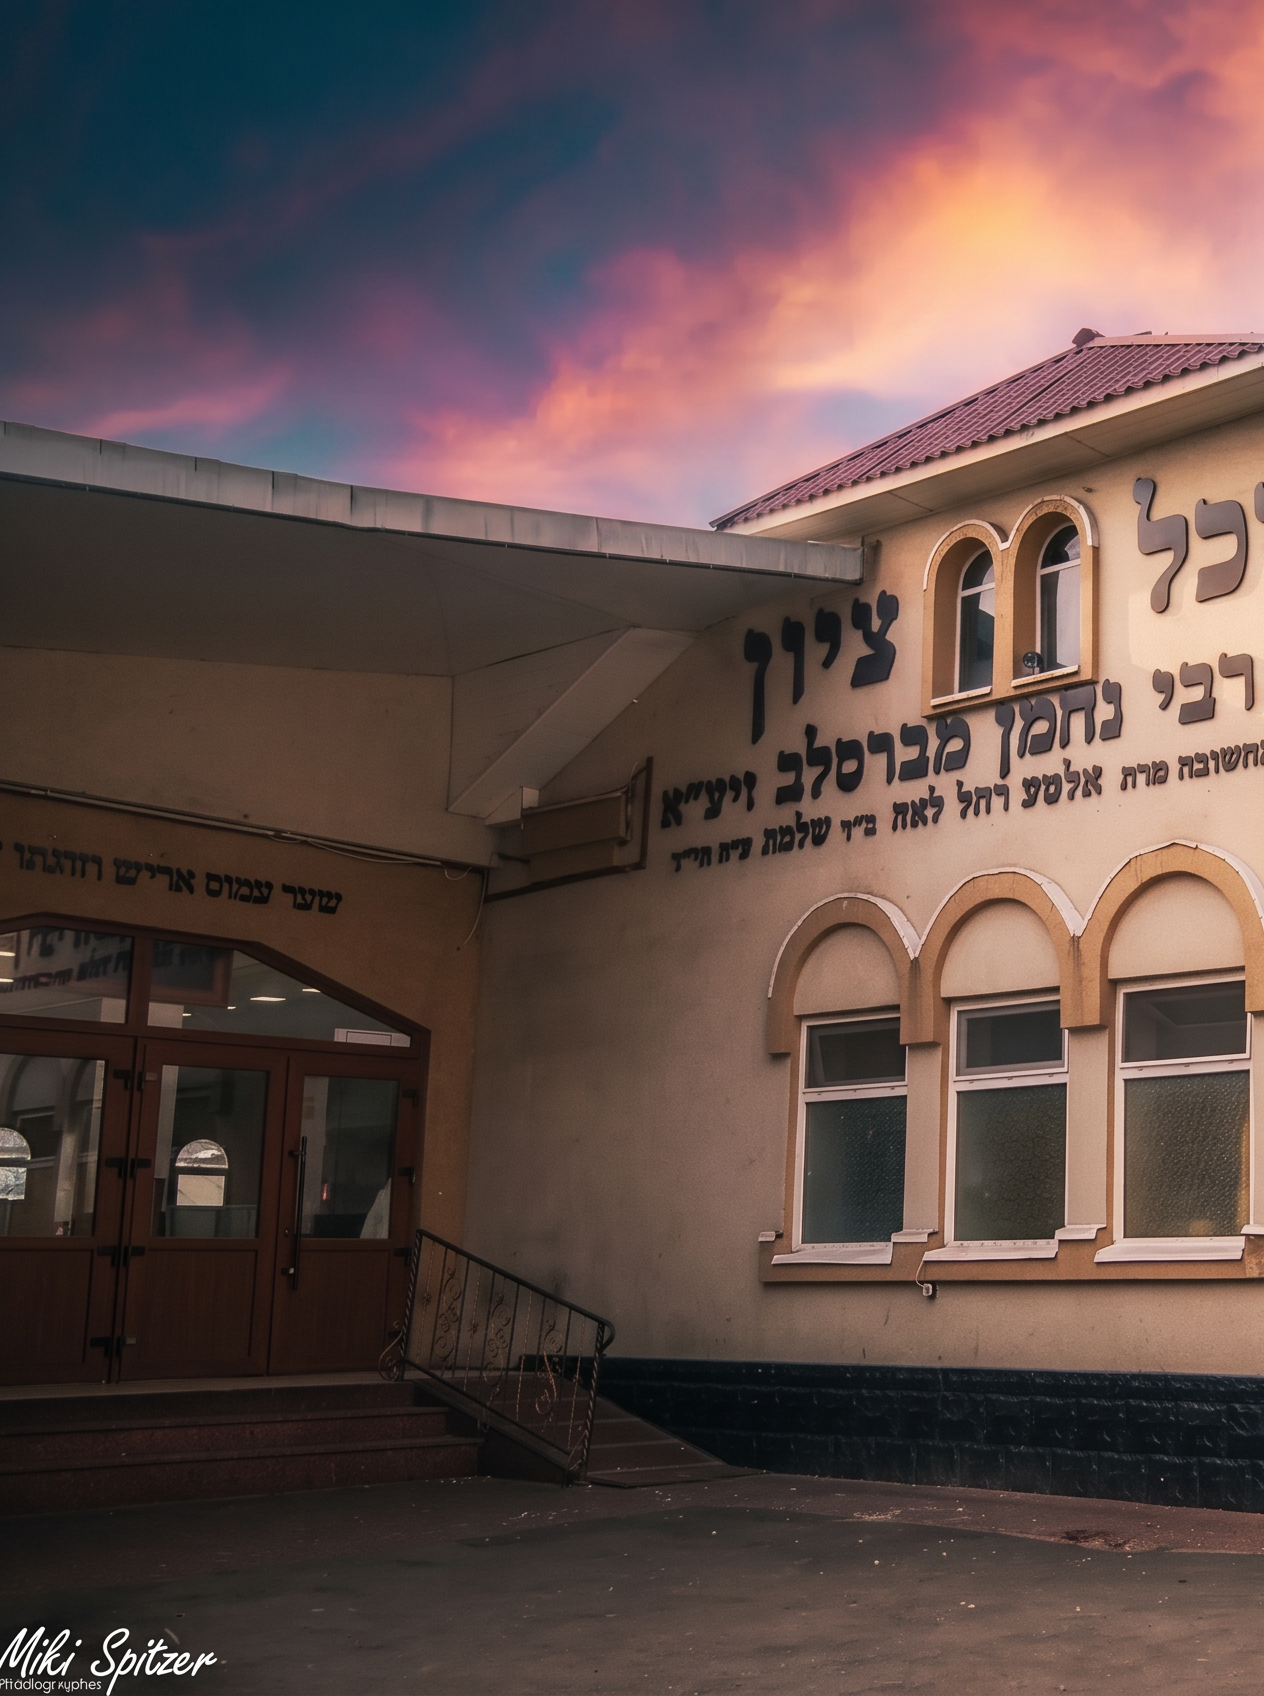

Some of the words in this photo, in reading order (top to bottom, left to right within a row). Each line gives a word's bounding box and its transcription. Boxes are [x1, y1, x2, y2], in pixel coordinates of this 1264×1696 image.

[744, 590, 899, 745] ציון
[1152, 652, 1254, 724] רבי
[995, 678, 1123, 779] נחמן
[775, 716, 971, 806] מברסלב
[1021, 757, 1102, 808] אלטע
[1120, 760, 1168, 791] מרת
[892, 784, 944, 832] לאה
[956, 779, 1009, 820] רחל
[113, 857, 196, 895] אריש
[205, 871, 274, 905] עמוס
[282, 883, 343, 915] שער
